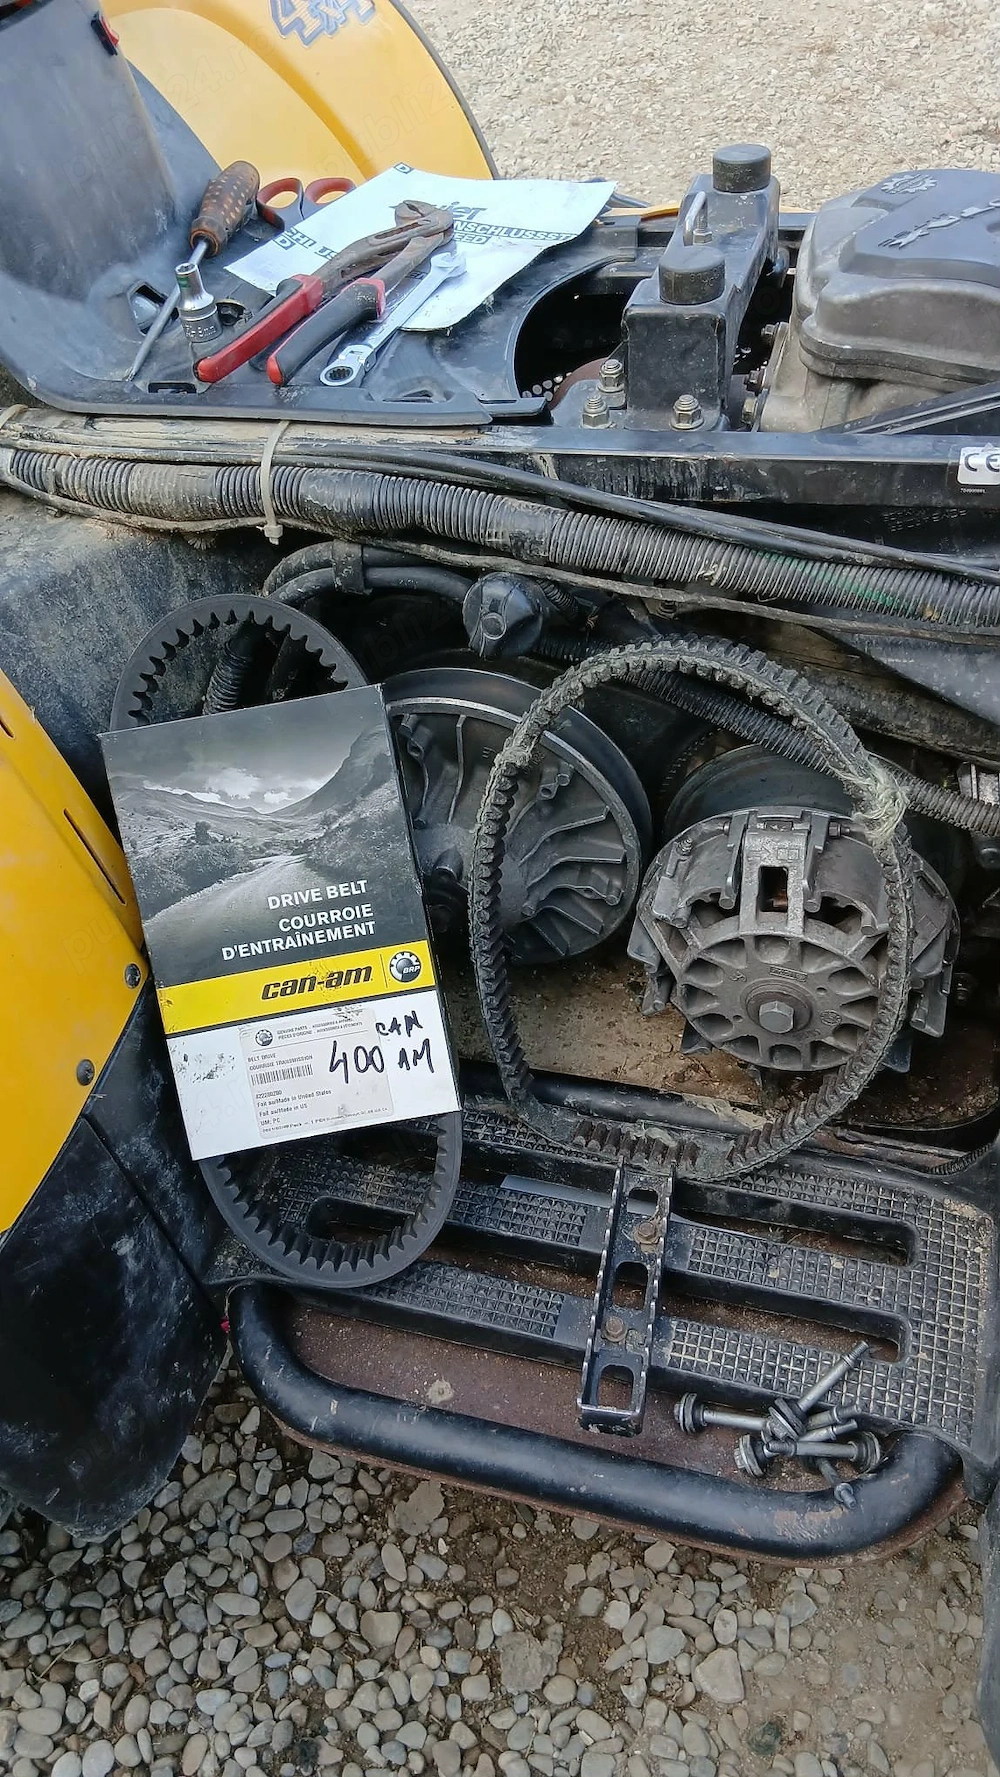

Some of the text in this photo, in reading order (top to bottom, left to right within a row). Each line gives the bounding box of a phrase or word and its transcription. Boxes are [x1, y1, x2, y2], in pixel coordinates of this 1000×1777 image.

[453, 220, 577, 241] NSCHLUSSST
[267, 879, 368, 910] DRIVE BELT
[278, 903, 374, 932] COURROIE
[221, 921, 376, 961] D'ENTRAÎNEMENT
[402, 965, 421, 974] BRP
[329, 1040, 385, 1084] 400
